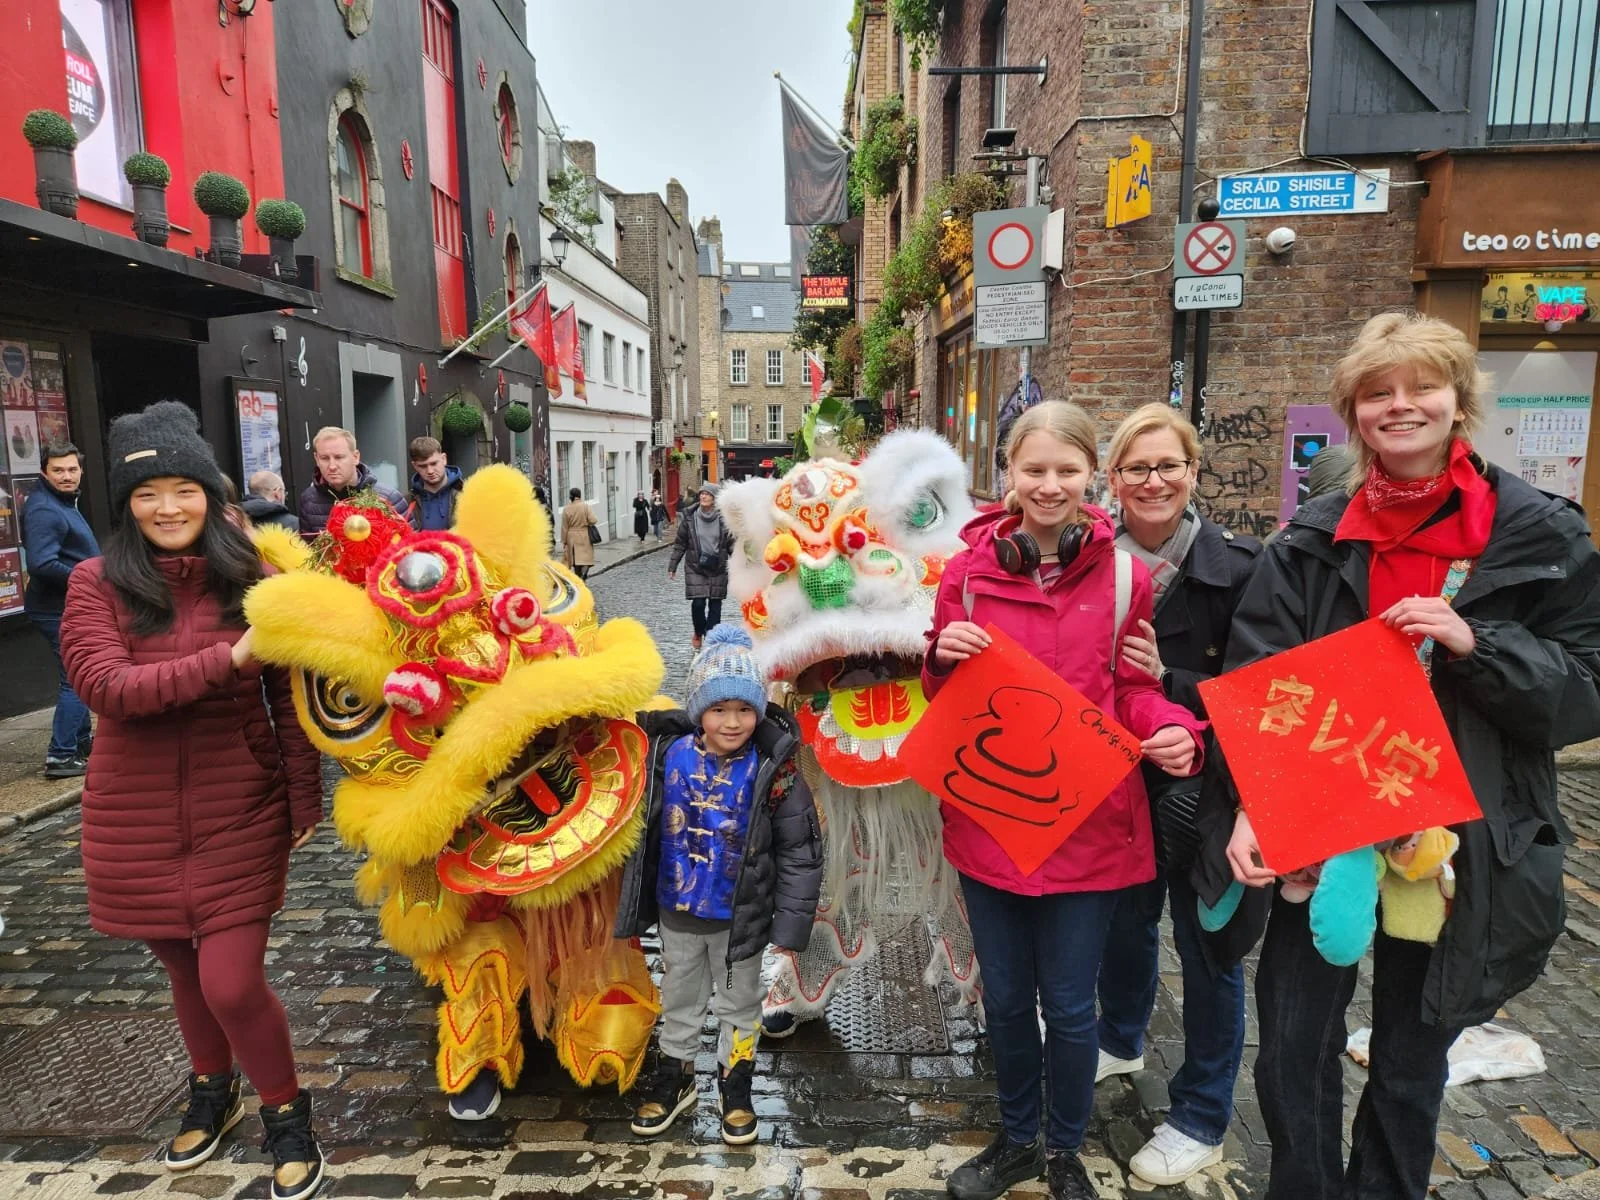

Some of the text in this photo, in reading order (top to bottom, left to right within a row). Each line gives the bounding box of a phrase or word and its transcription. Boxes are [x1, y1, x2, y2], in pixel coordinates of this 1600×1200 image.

[1232, 177, 1345, 194] SRÁID SHISILE
[1365, 182, 1377, 200] 2
[1223, 193, 1350, 211] CECILIA STREET
[1462, 231, 1508, 250] tea
[1536, 228, 1600, 250] time
[803, 276, 849, 287] THE TEMPLE
[807, 286, 844, 297] BAR LANE
[1178, 292, 1239, 303] AT ALL TIMES
[1537, 286, 1587, 304] VAPE
[1535, 303, 1585, 320] SHOP
[1497, 395, 1590, 404] SECOND CUP HALF PRICE
